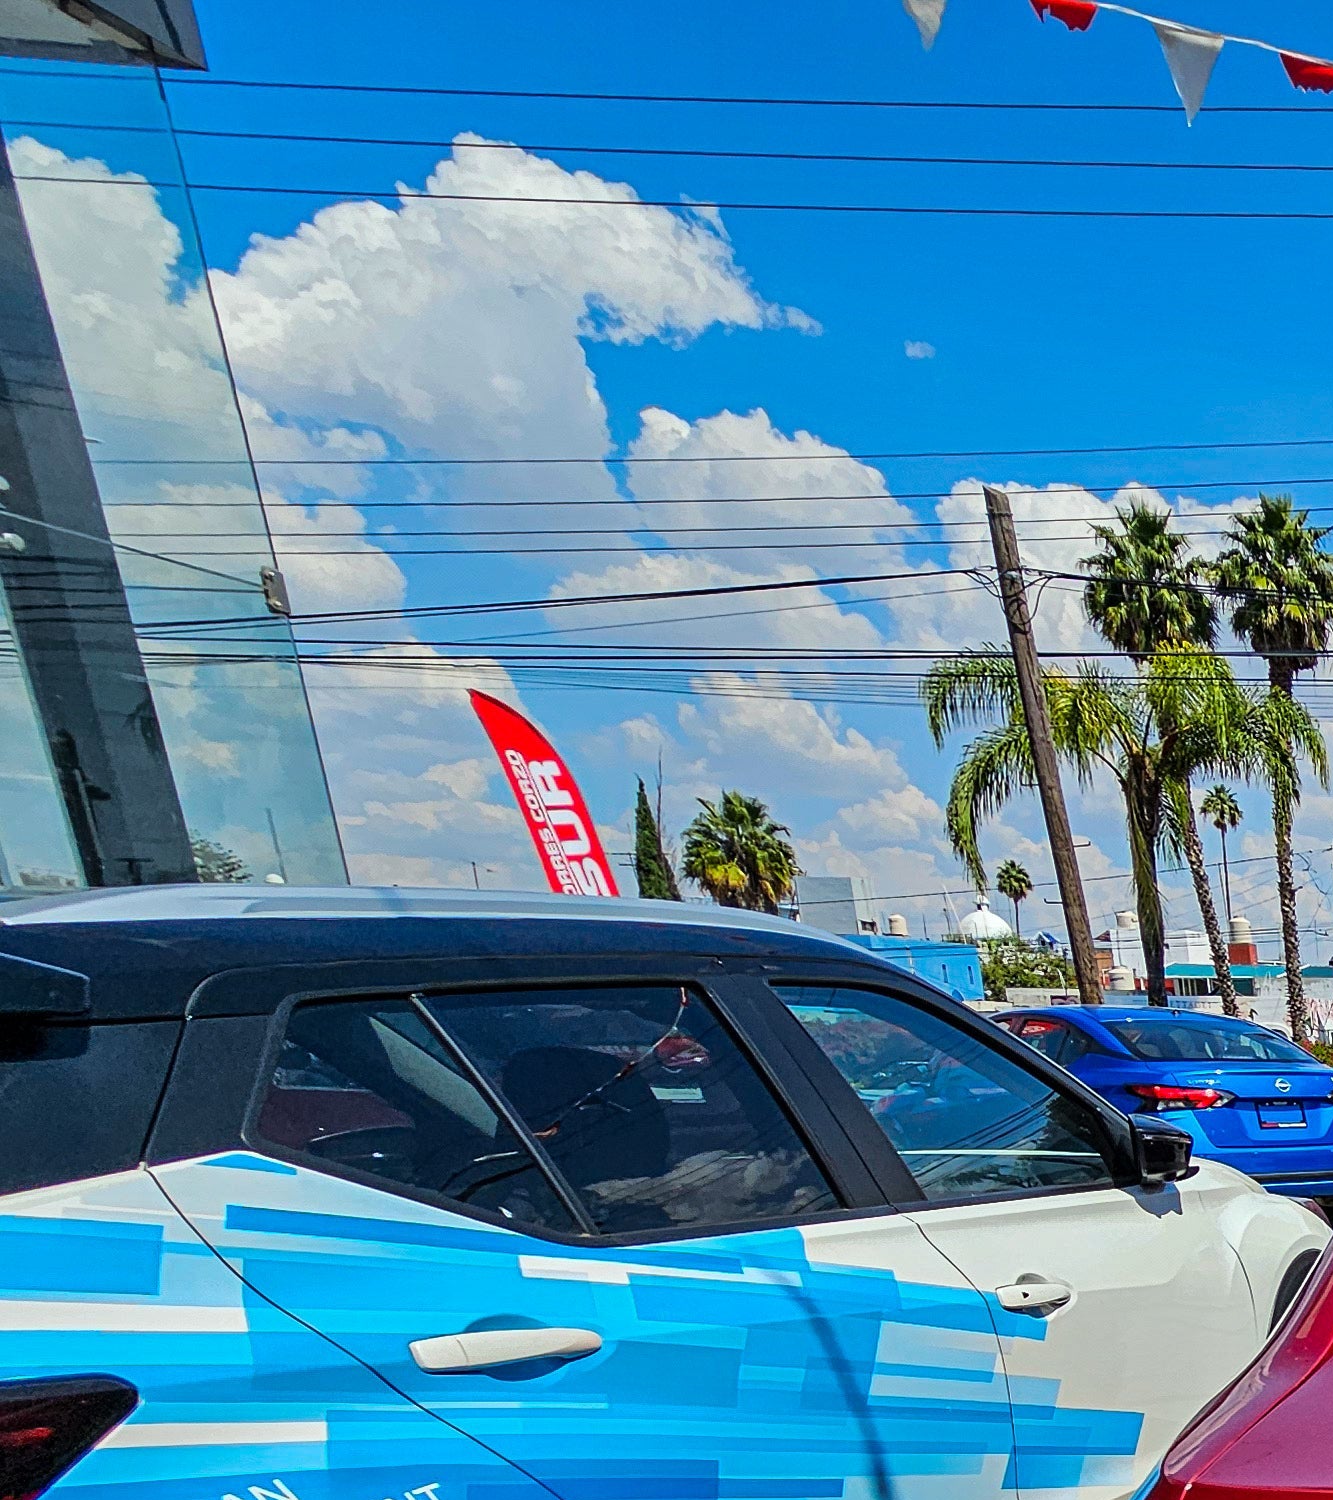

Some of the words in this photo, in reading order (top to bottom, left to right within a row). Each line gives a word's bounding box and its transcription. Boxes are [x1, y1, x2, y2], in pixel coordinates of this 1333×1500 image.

[504, 749, 546, 823] CORZO
[527, 759, 612, 897] SUR
[537, 827, 579, 896] ORRES
